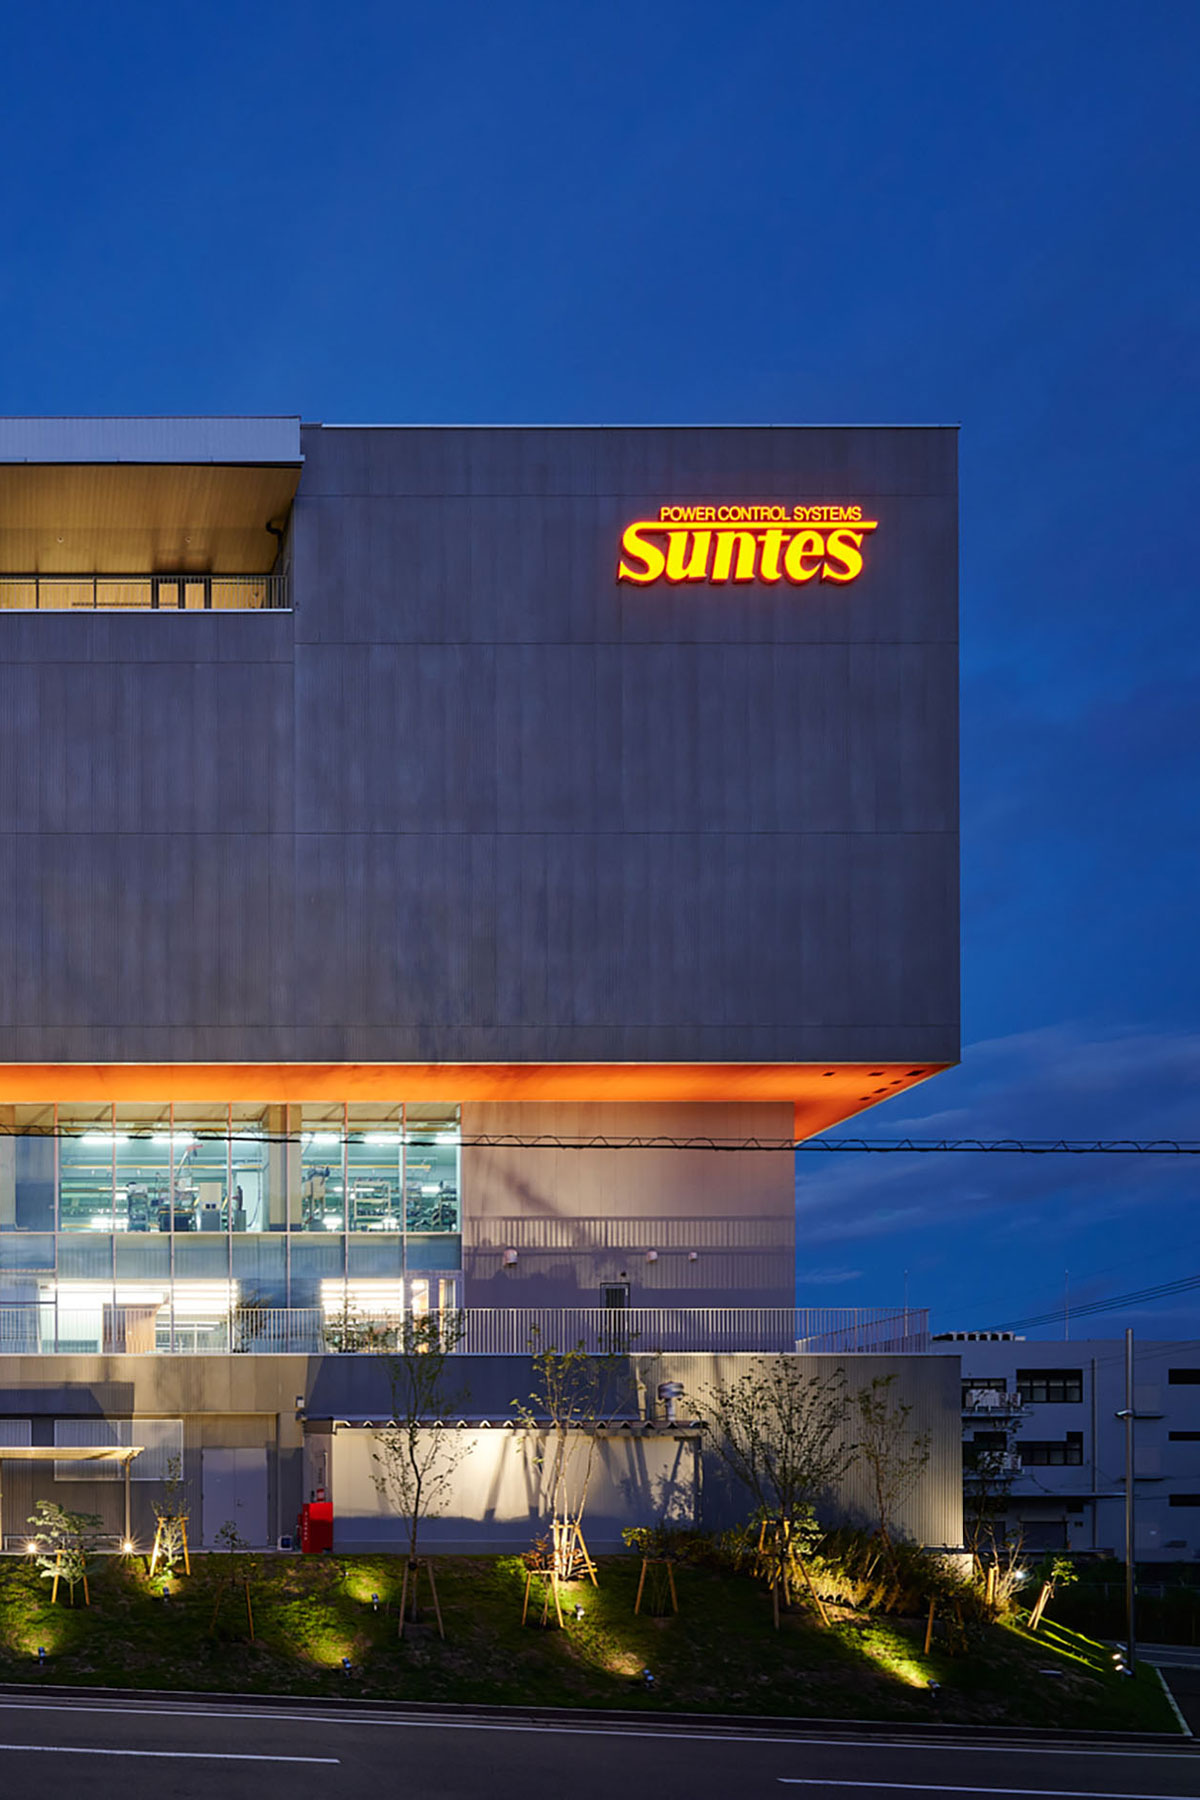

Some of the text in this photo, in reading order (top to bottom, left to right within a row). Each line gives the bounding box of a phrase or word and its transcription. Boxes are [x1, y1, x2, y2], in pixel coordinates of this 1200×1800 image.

[660, 505, 862, 521] POWER CONTROL SYSTEMS
[617, 521, 879, 583] Suntes
